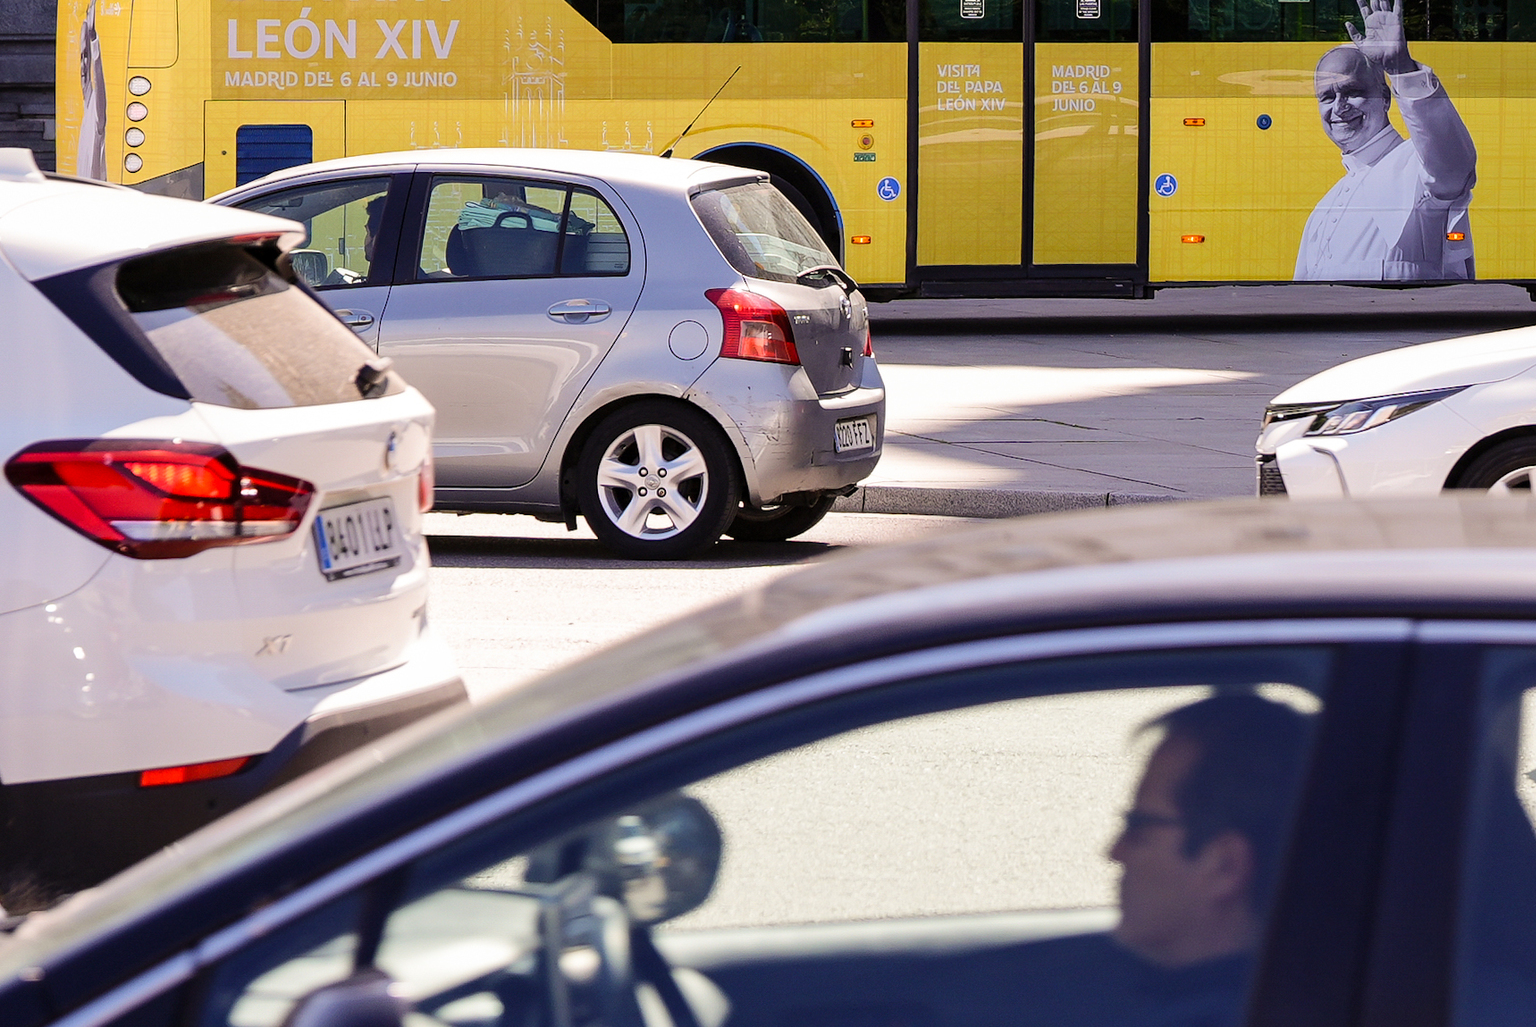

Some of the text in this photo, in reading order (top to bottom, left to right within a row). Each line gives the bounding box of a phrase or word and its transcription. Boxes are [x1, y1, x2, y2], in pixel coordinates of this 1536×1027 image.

[227, 7, 460, 60] LEÓN XIV
[937, 64, 980, 77] VISITA
[1052, 65, 1110, 80] MADRID
[224, 71, 458, 90] MADRID DEL 6 AL 9 JUNIO
[937, 81, 1003, 94] DEL PAPA
[1052, 81, 1122, 94] DEL 6 AL 9
[937, 95, 1006, 111] LEÓN XIV
[1052, 98, 1095, 112] JUNIO
